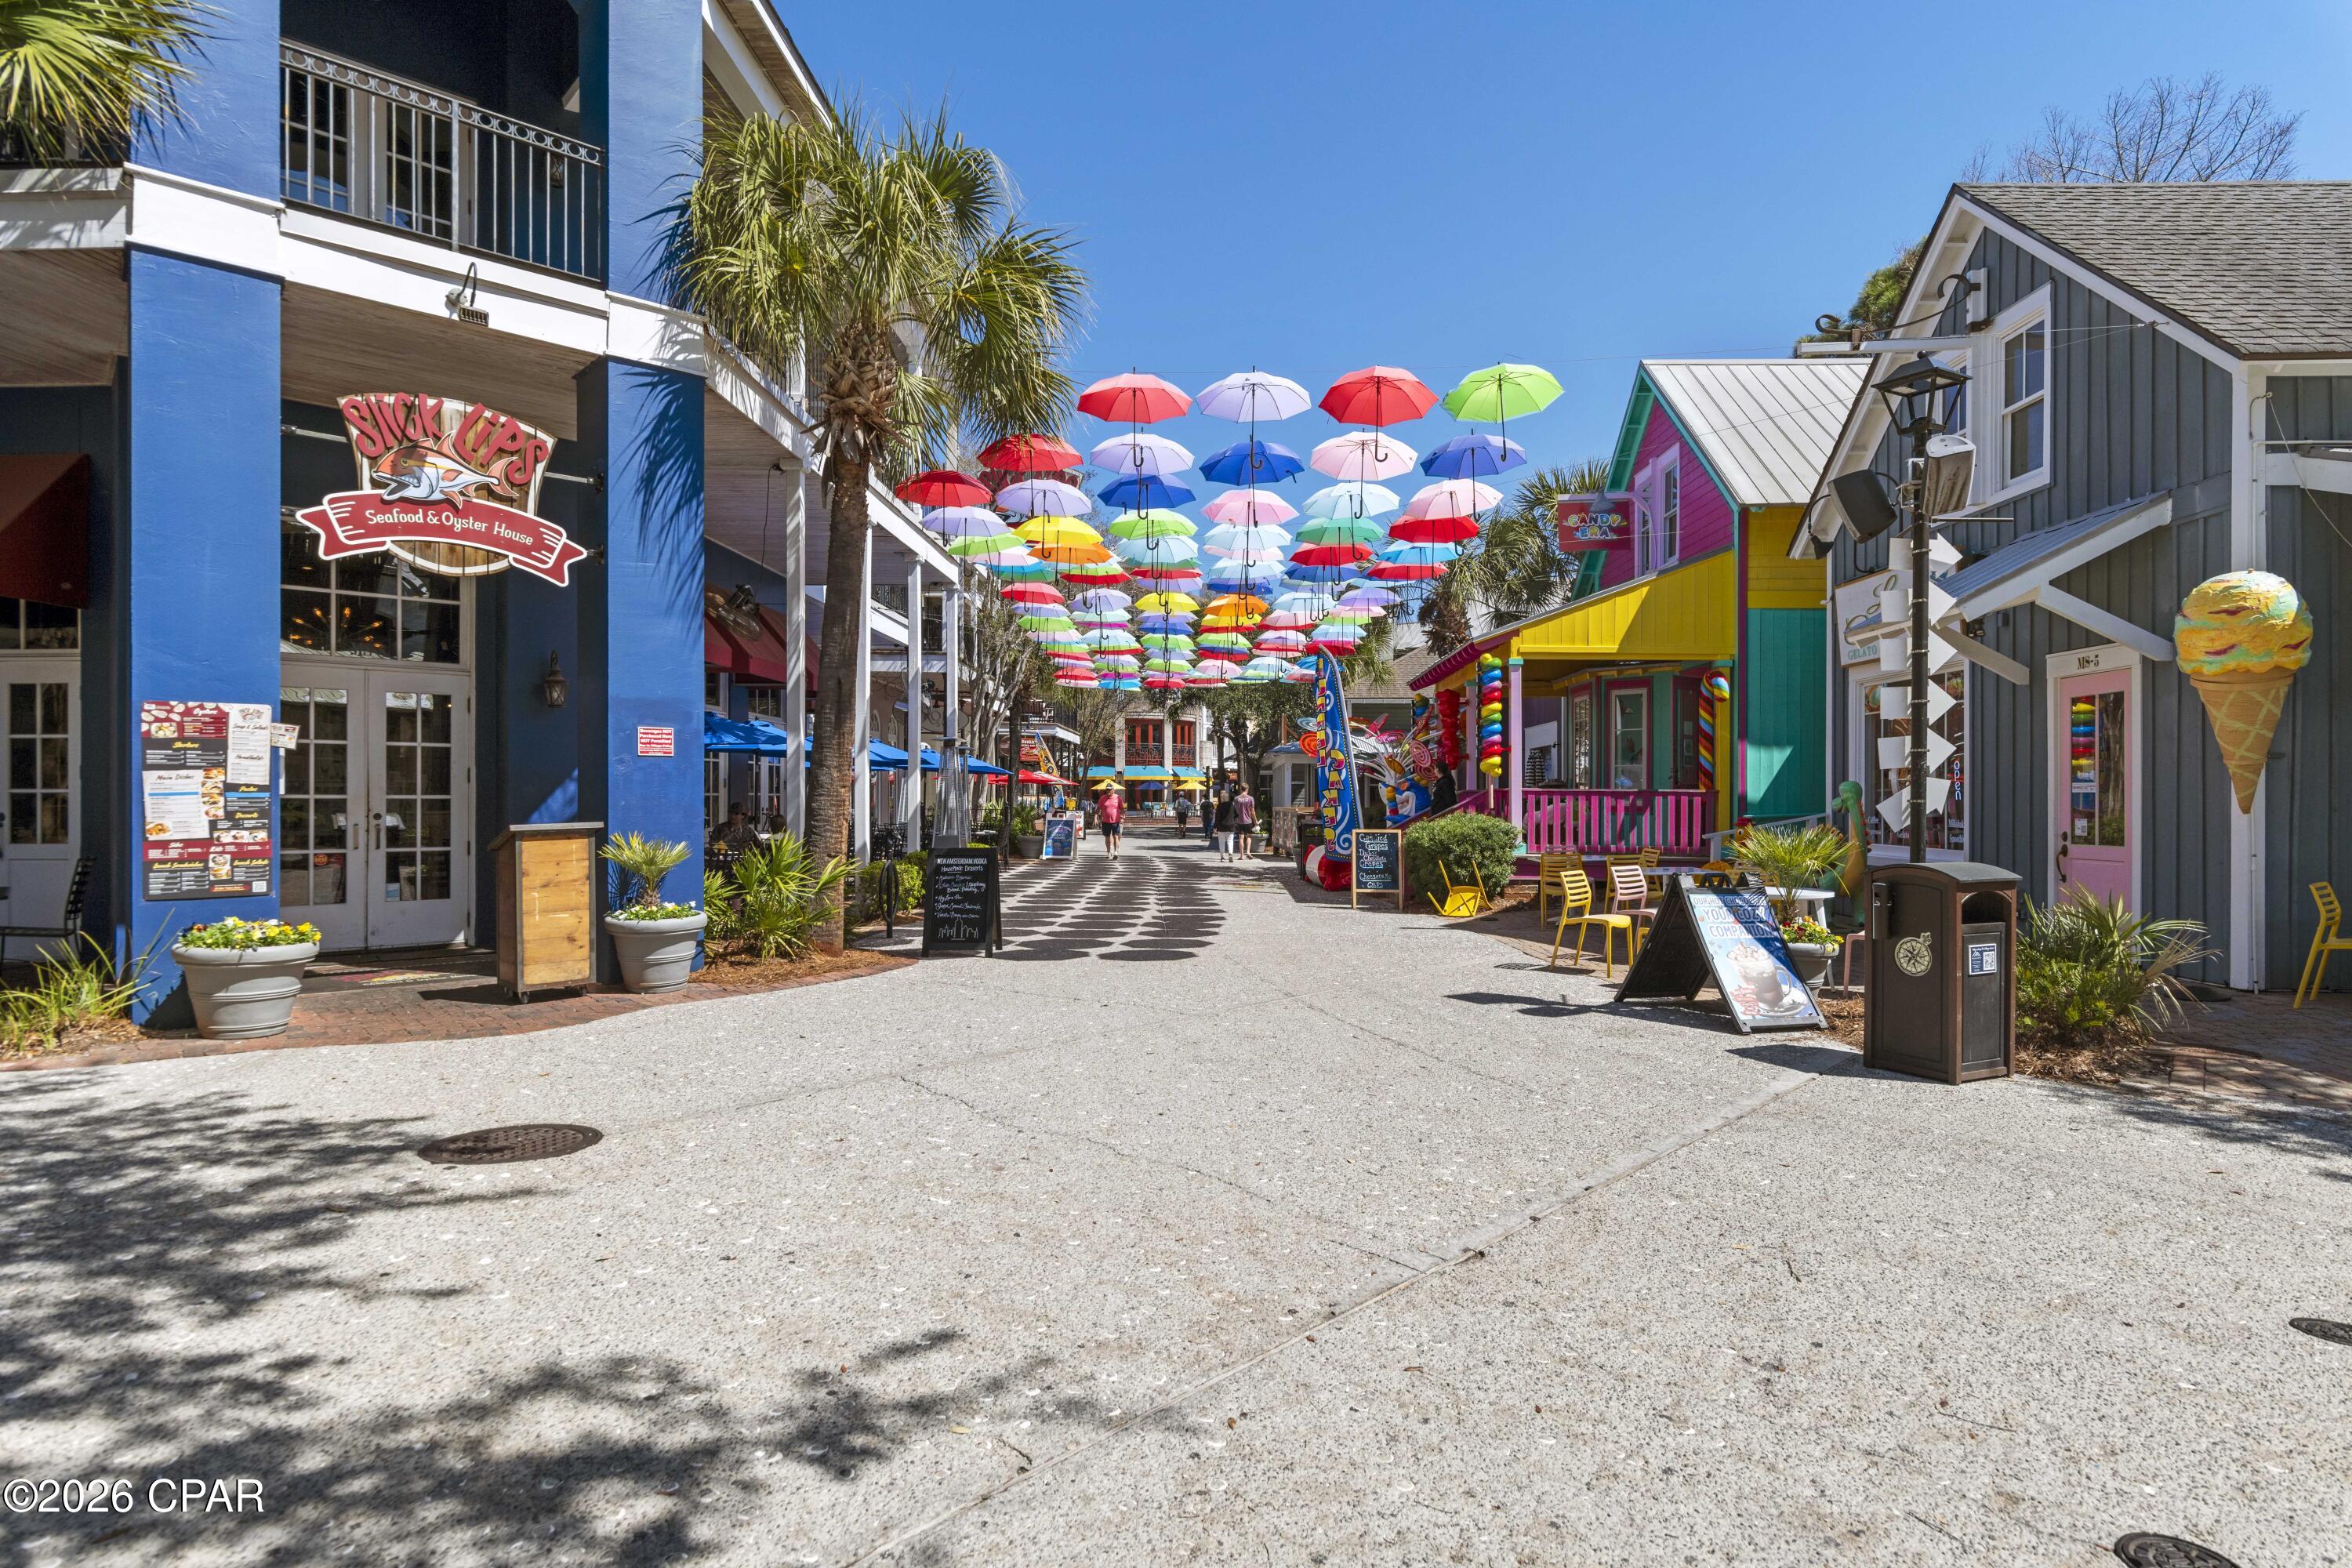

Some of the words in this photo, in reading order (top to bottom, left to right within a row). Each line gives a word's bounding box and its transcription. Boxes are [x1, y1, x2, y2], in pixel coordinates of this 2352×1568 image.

[365, 508, 424, 524] Seafood
[426, 511, 440, 524] &
[441, 512, 488, 532] Oyster
[493, 521, 533, 546] House
[1568, 513, 1621, 528] CANDY
[1578, 525, 1610, 539] ERA
[1847, 645, 1878, 660] GELATO
[1365, 842, 1388, 851] Grapes
[1693, 896, 1708, 906] OUR
[1710, 896, 1725, 906] HOT
[1703, 908, 1735, 921] YOUR
[1736, 908, 1766, 921] COZY
[1709, 924, 1774, 938] COMPANION
